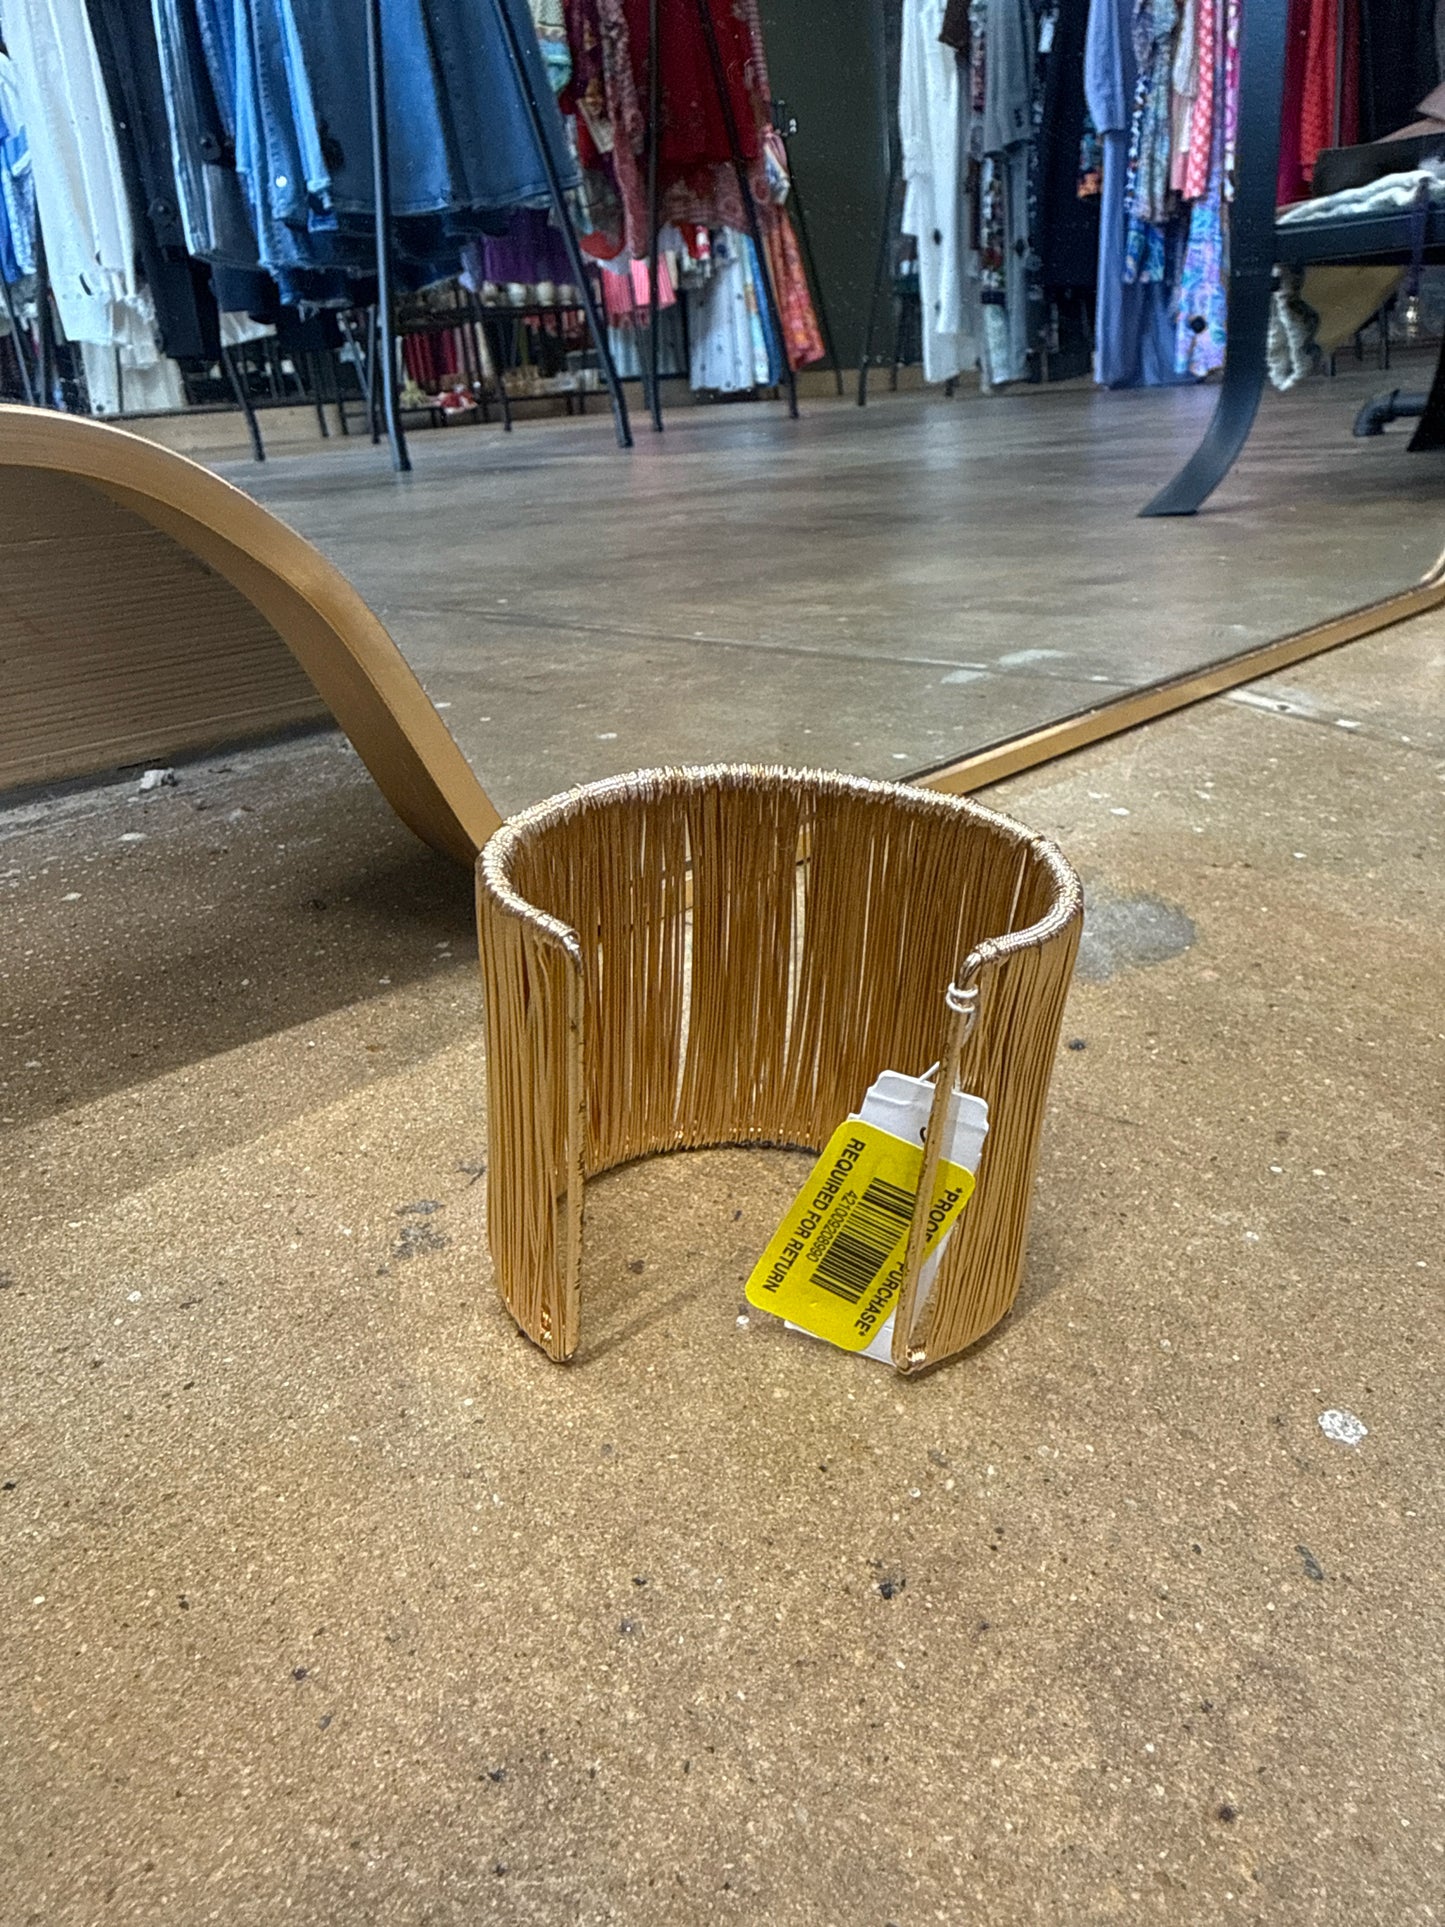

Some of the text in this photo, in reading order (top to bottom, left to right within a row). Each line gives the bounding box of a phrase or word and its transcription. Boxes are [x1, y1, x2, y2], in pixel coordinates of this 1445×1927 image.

[762, 1137, 866, 1293] REQUIRED FOR RETURN
[806, 1189, 858, 1263] 421009208990
